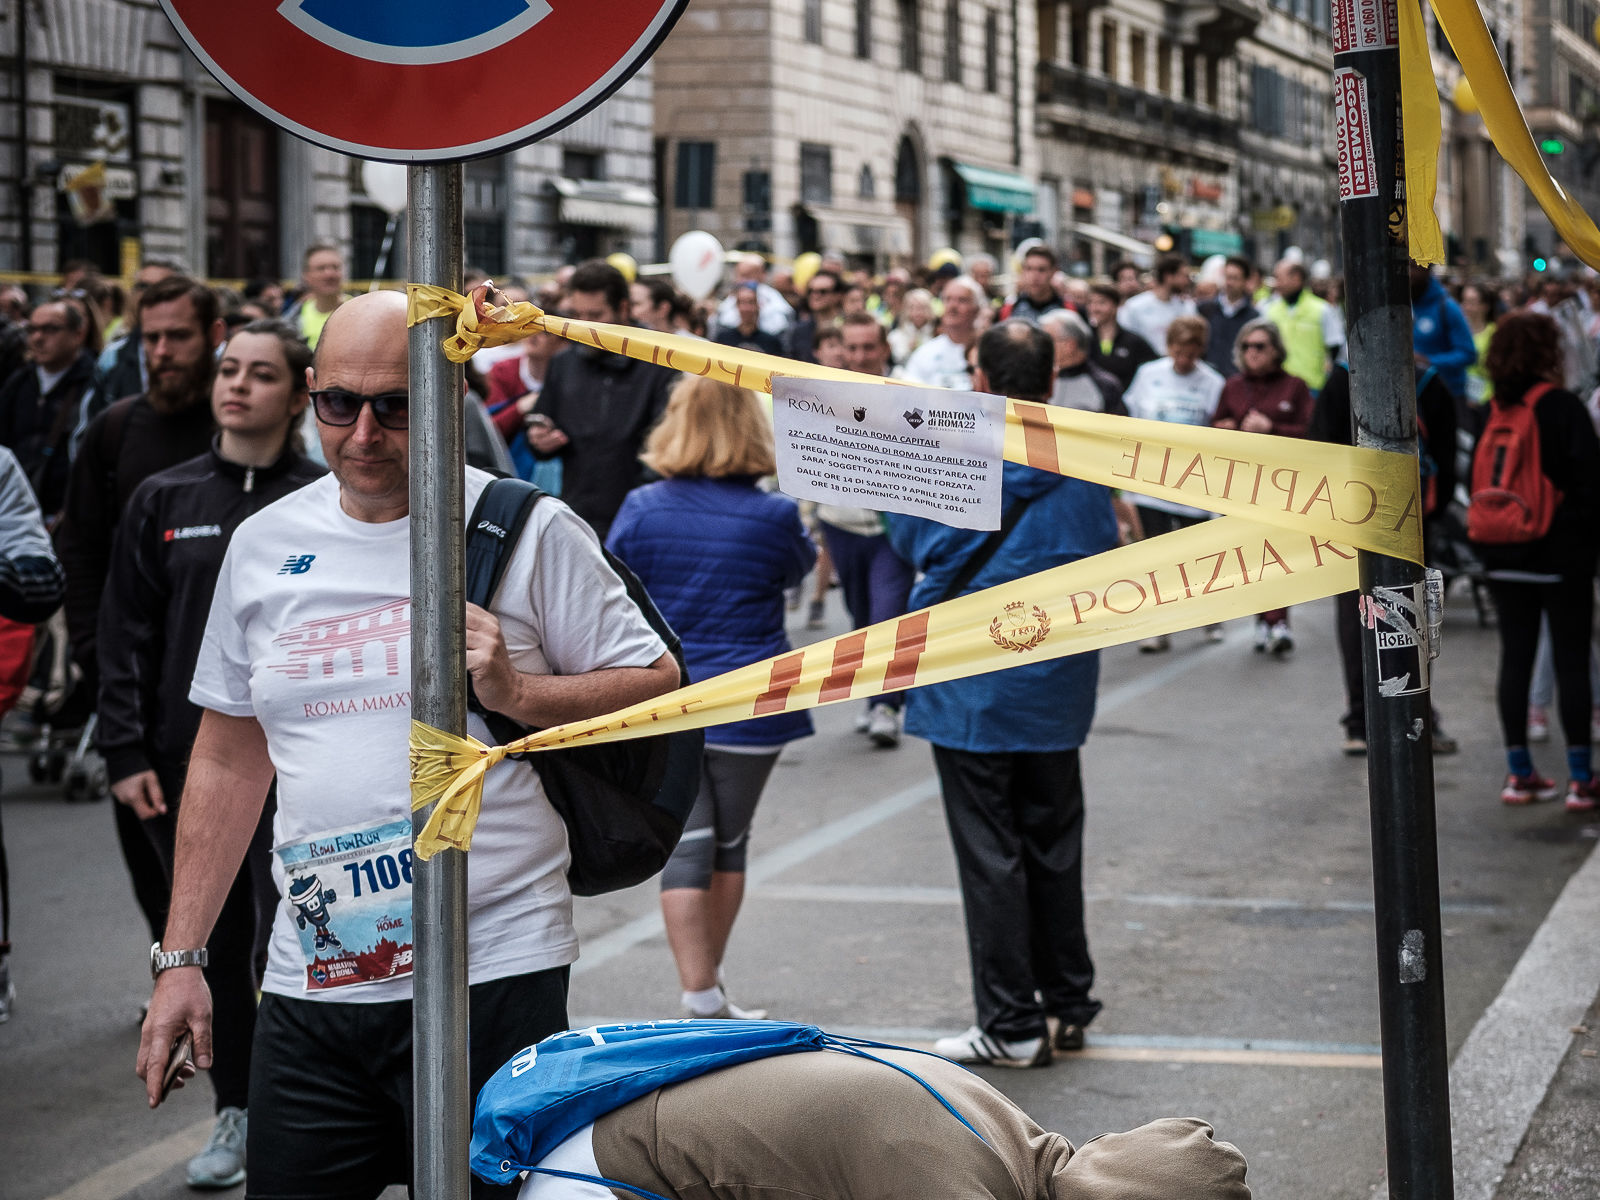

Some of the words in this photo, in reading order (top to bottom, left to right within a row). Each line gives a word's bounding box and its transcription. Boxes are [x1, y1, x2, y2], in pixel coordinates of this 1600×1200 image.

[1362, 9, 1375, 25] 090
[1364, 28, 1377, 44] 346
[1345, 77, 1367, 191] SGOMBERI
[788, 398, 836, 417] ROMA
[928, 409, 976, 421] MARATONA
[927, 418, 937, 426] di
[835, 425, 869, 437] POLIZIA
[870, 431, 898, 442] ROMA
[900, 435, 940, 447] CAPITALE
[800, 445, 829, 455] PREGA
[841, 453, 861, 461] NON
[863, 457, 900, 469] SOSTARE
[805, 432, 828, 442] ACEA
[829, 437, 880, 453] MARATONA
[882, 447, 891, 455] DI
[893, 448, 921, 460] ROMA
[935, 455, 965, 465] APRILE
[967, 459, 988, 468] 2016
[801, 455, 826, 464] SARA'
[828, 460, 873, 474] SOGGETTA
[883, 470, 932, 485] RIMOZIONE
[934, 479, 976, 491] FORZATA.
[796, 467, 822, 477] DALLE
[824, 472, 840, 482] ORE
[866, 480, 900, 491] SABATO
[909, 487, 938, 498] APRILE
[939, 493, 960, 502] 2016
[811, 480, 829, 489] ORE
[830, 483, 840, 491] 18
[853, 488, 900, 500] DOMENICA
[914, 497, 942, 509] APRILE
[944, 504, 967, 514] 2016.
[1067, 538, 1295, 625] POLIZIA
[303, 698, 358, 718] ROMA
[376, 918, 404, 933] HOME
